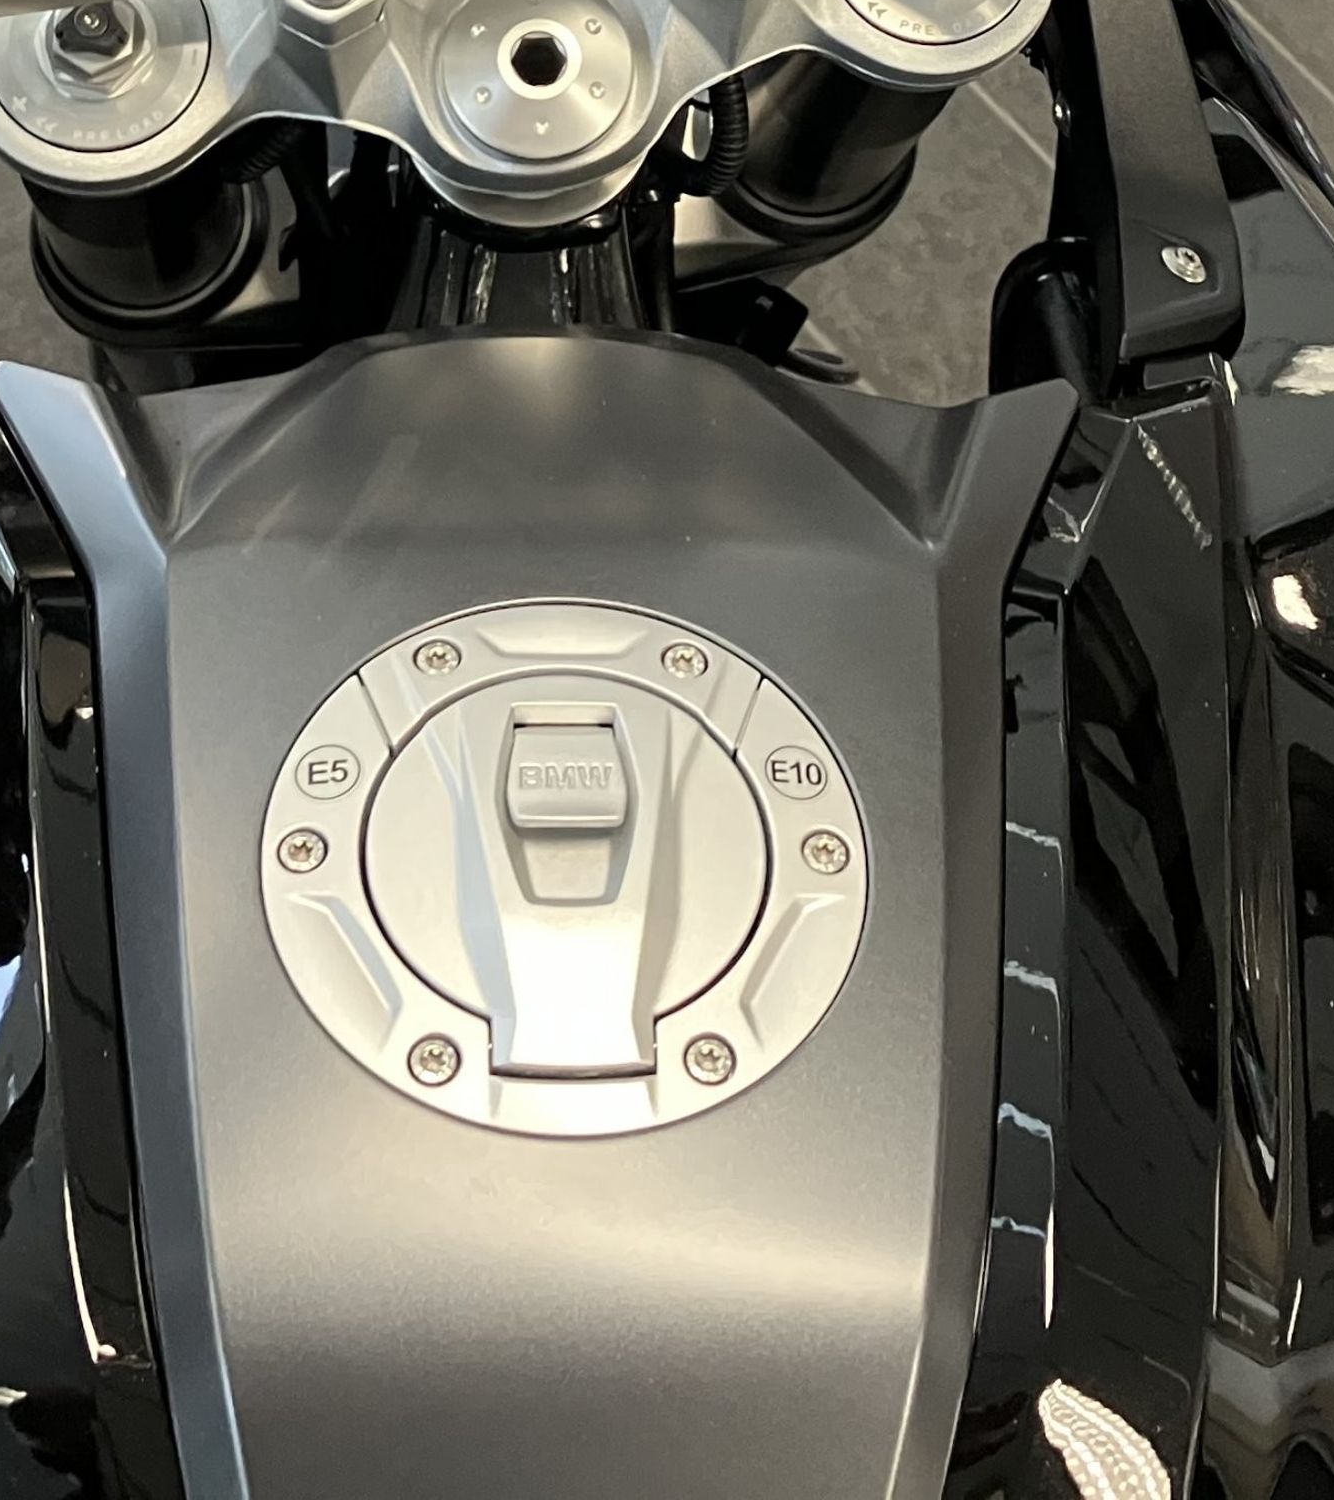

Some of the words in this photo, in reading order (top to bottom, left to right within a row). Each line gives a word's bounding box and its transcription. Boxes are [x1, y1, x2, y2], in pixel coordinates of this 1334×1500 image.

[308, 758, 349, 786] E5
[518, 761, 614, 790] BMW
[770, 760, 822, 786] E10
